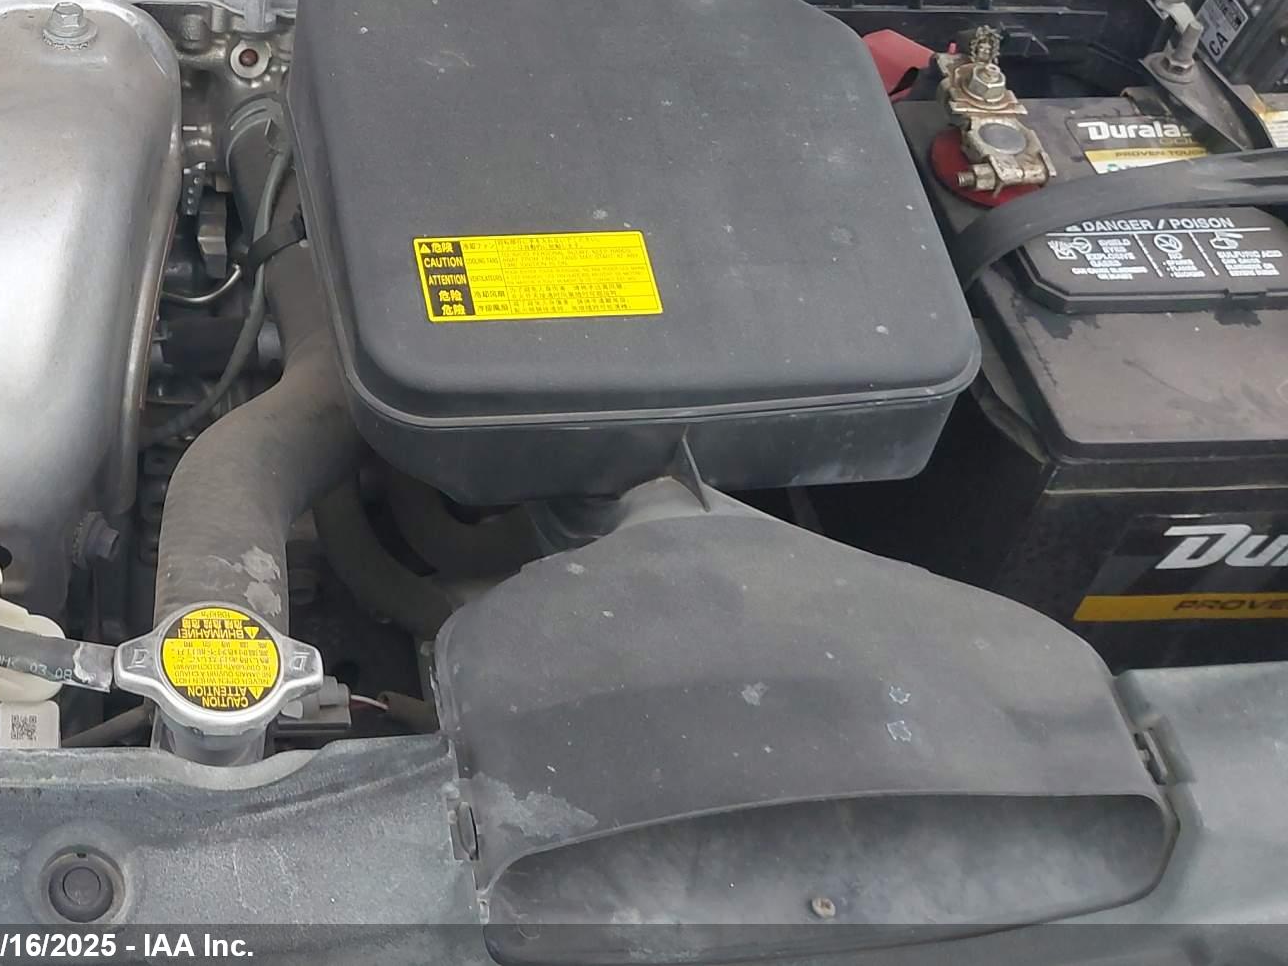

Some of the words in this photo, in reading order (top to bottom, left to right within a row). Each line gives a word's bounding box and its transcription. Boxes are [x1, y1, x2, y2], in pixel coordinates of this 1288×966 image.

[1082, 219, 1154, 232] DANGER
[1169, 217, 1235, 229] POISON
[424, 257, 463, 268] CAUTION
[428, 274, 467, 285] ATTENTION
[187, 687, 247, 697] ATTENTION
[202, 697, 249, 708] CAUTION
